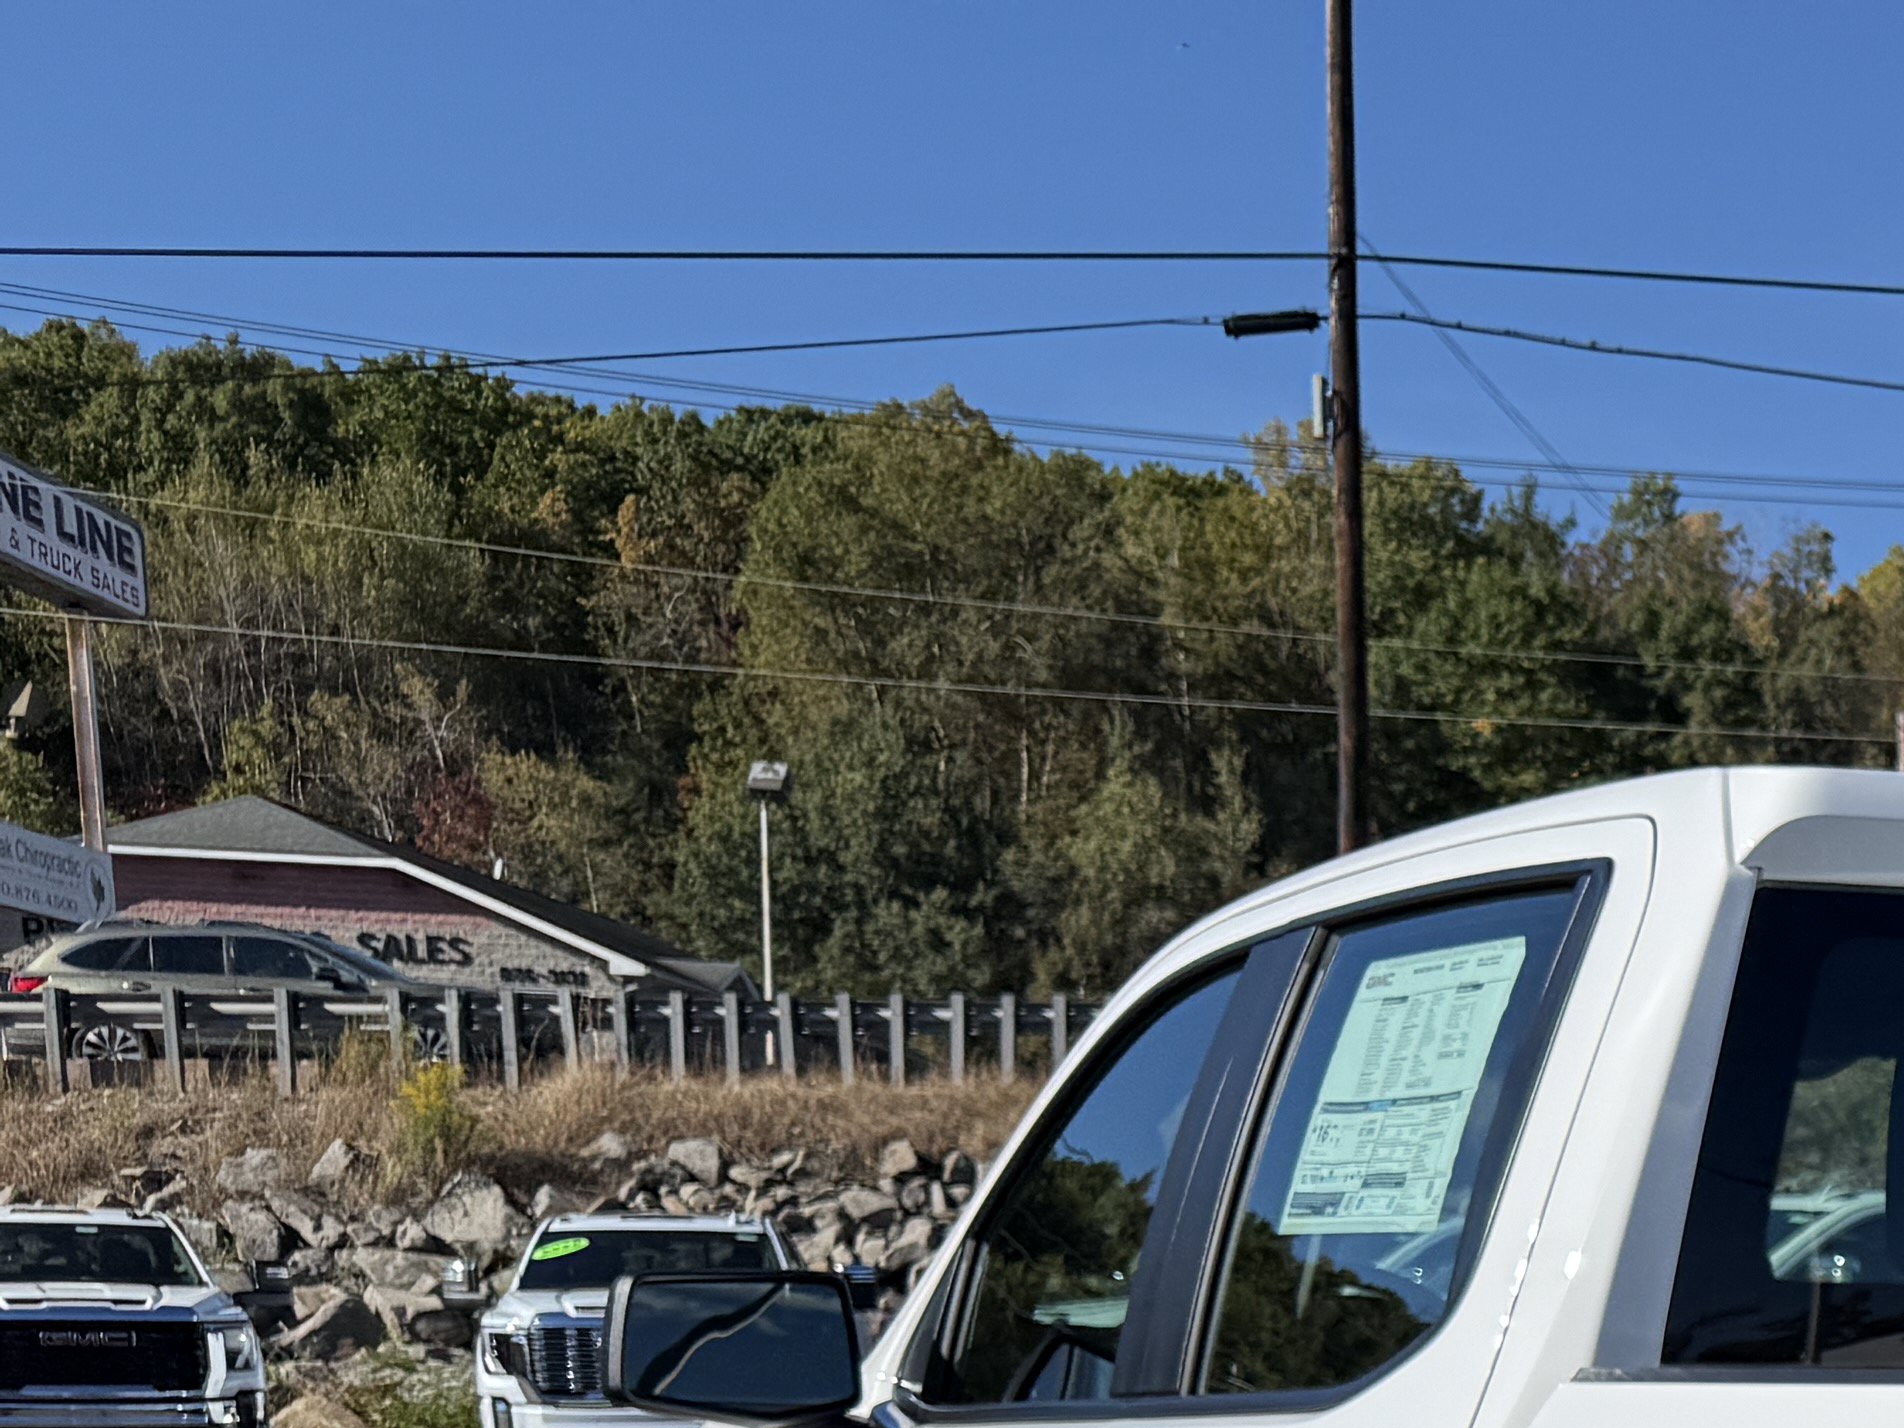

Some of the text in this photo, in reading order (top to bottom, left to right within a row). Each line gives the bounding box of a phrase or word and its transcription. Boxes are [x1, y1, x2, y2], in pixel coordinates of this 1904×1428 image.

[53, 492, 138, 578] LINE
[9, 526, 140, 608] & TRUCK SALES
[15, 837, 82, 880] Chiropractic
[356, 931, 474, 968] SALES
[38, 1331, 137, 1348] GMC
